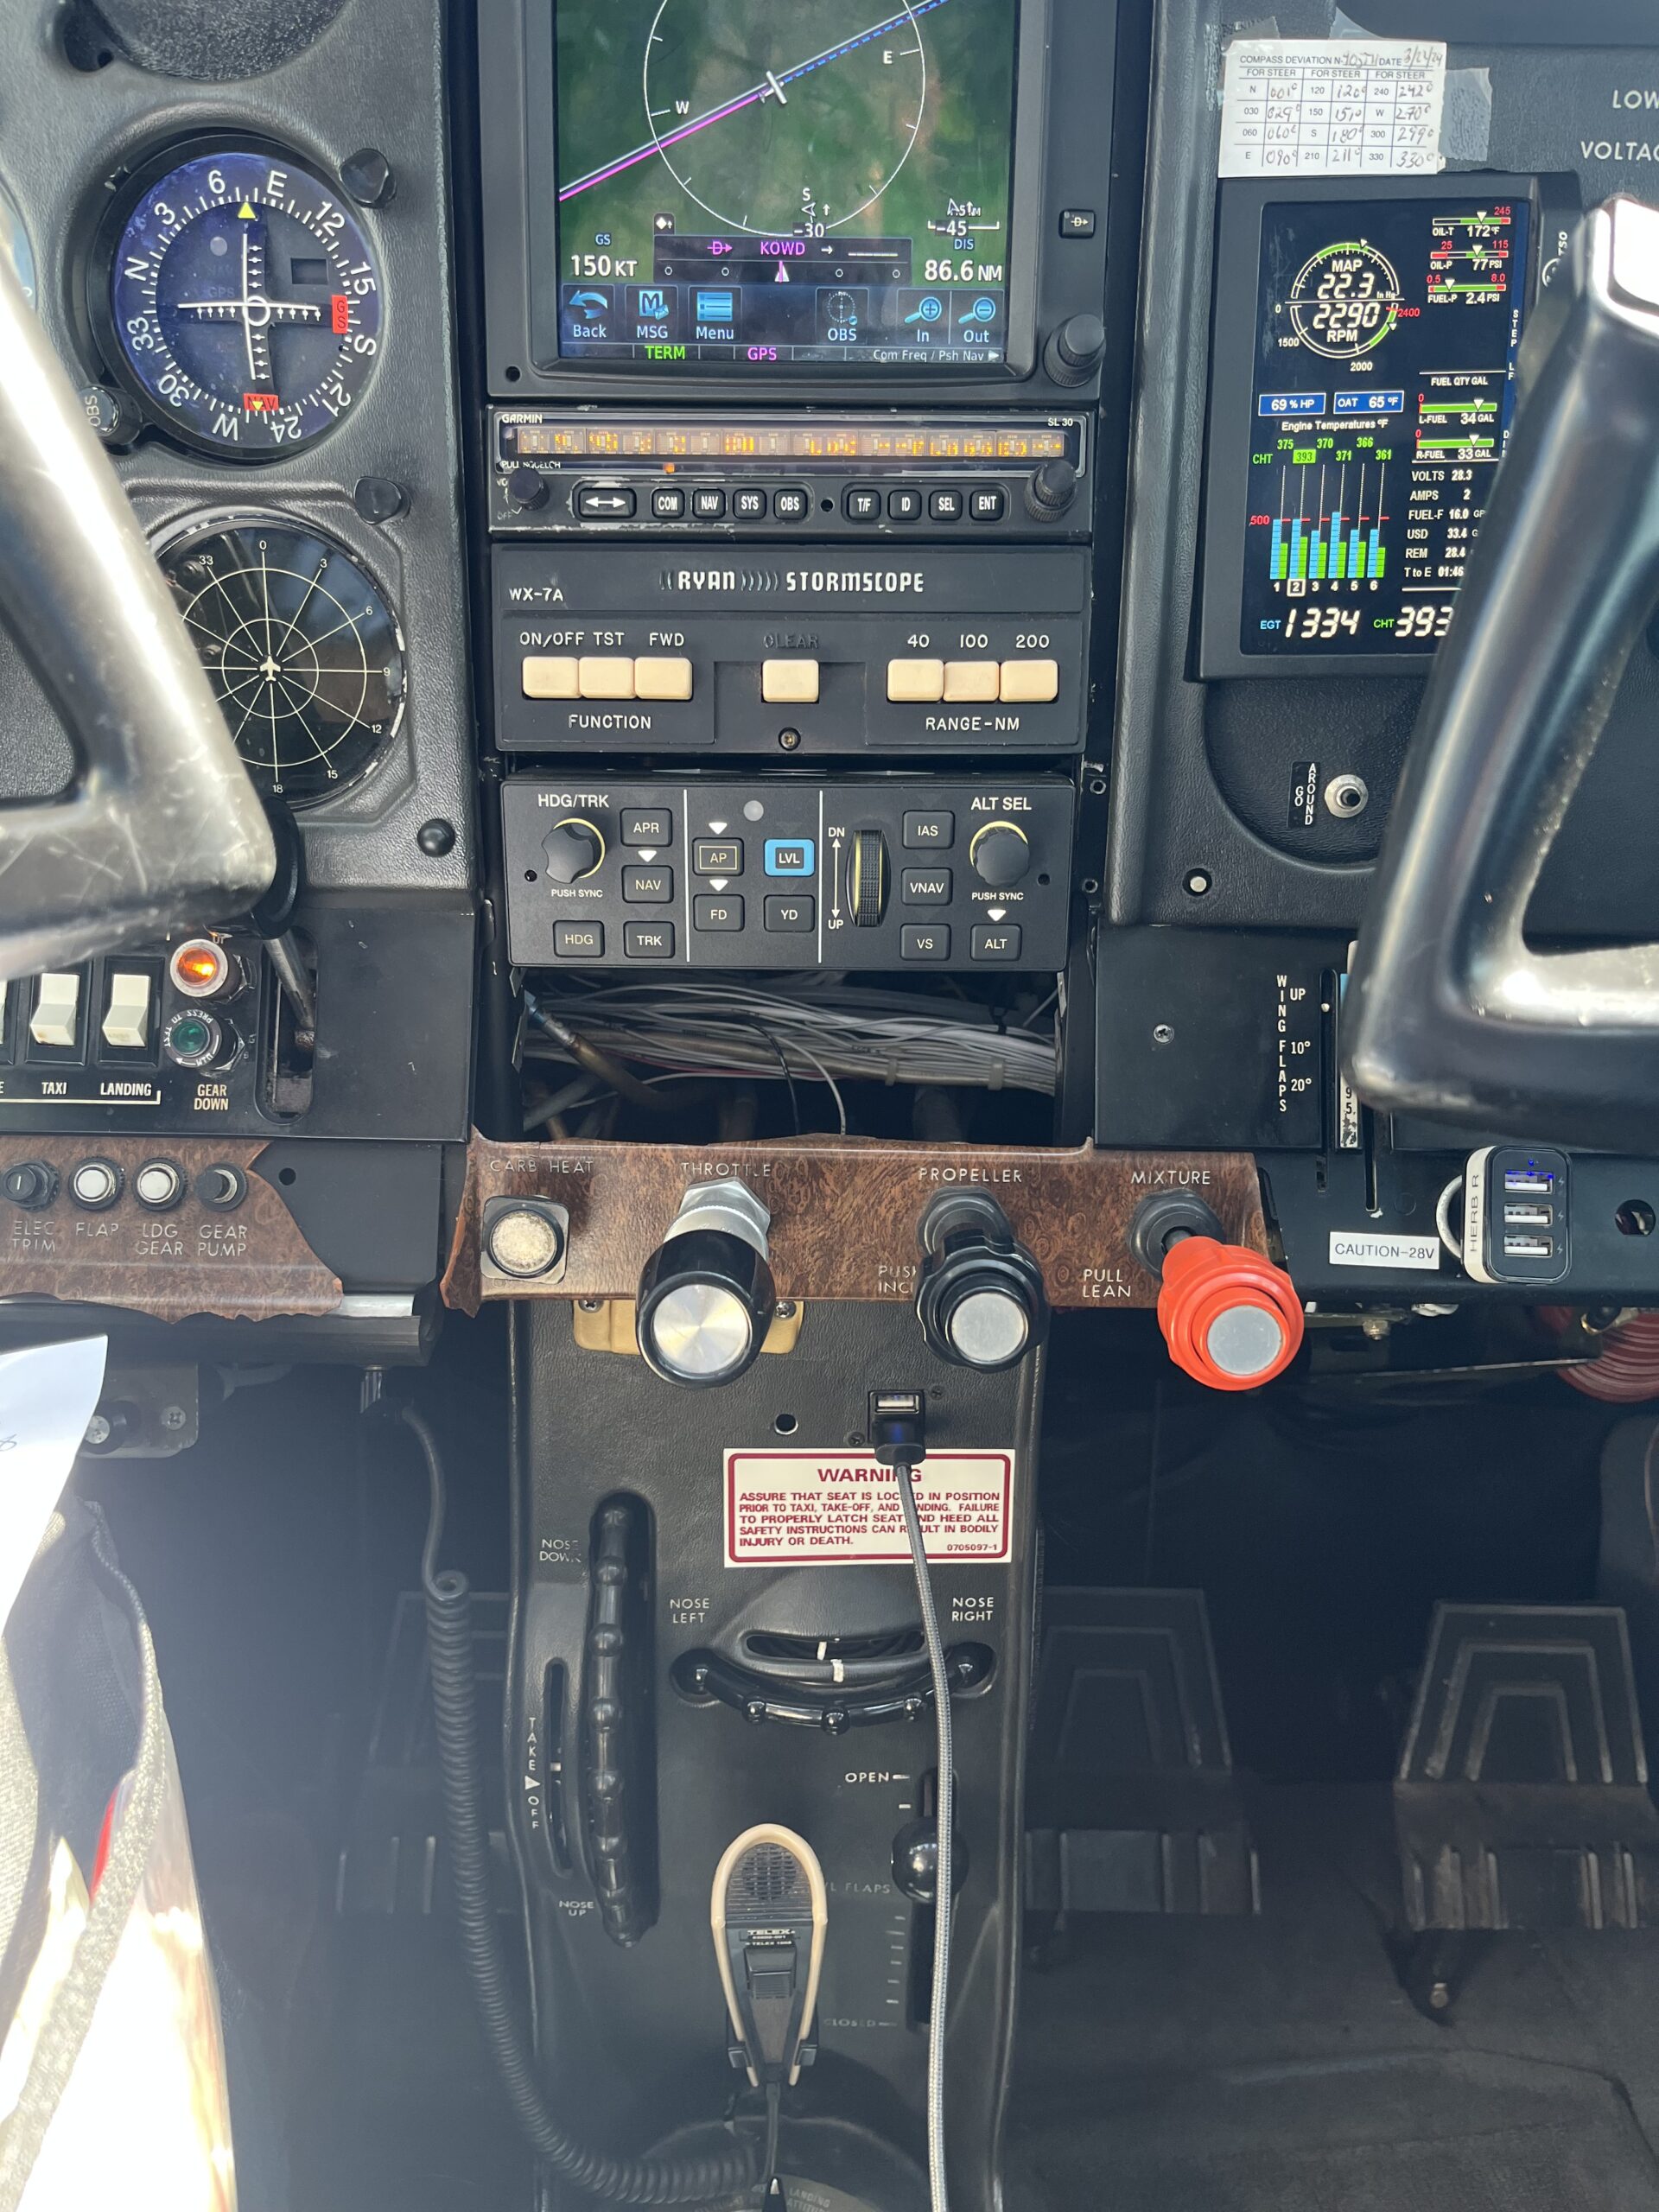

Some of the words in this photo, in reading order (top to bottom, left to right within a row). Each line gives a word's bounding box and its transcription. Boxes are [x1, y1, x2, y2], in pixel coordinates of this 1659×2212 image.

[1240, 55, 1284, 64] COMPASS
[1286, 56, 1332, 65] DEVIATION
[1268, 68, 1296, 77] STEER
[208, 170, 226, 194] 6
[266, 170, 288, 198] E
[154, 201, 176, 226] 3
[315, 201, 346, 238] 12
[1432, 227, 1454, 237] OIL-T
[1466, 225, 1491, 238] 172
[594, 233, 611, 246] GS
[954, 238, 975, 251] DIS
[760, 241, 806, 257] KOWD
[124, 257, 149, 282] N
[571, 255, 612, 277] 150
[614, 260, 639, 277] KT
[924, 261, 975, 281] 86.6
[977, 264, 1003, 282] NM
[1332, 260, 1363, 273] MAP
[349, 261, 377, 296] 15
[1317, 274, 1375, 300] 22.3
[1427, 294, 1458, 304] FUEL-P
[1313, 302, 1381, 329] 2290
[1397, 308, 1421, 317] 2400
[127, 316, 155, 352] 33
[572, 324, 607, 339] Back
[636, 326, 669, 340] MSG
[696, 326, 734, 340] Menu
[827, 327, 857, 342] OBS
[916, 329, 931, 343] In
[963, 329, 990, 343] Out
[1326, 330, 1358, 343] RPM
[353, 334, 378, 357] S
[1278, 337, 1300, 347] 1500
[645, 346, 686, 360] TERM
[747, 346, 778, 361] GPS
[873, 348, 895, 361] Com
[899, 348, 928, 363] Freq
[939, 349, 959, 362] Psh
[963, 351, 985, 363] Nav
[1350, 361, 1373, 372] 2000
[157, 373, 190, 408] 30
[321, 381, 352, 417] 21
[1338, 397, 1358, 408] OAT
[1369, 397, 1384, 409] 65
[85, 395, 101, 427] OBS
[501, 414, 543, 424] GARMIN
[212, 413, 239, 442] W
[270, 416, 302, 443] 24
[1281, 421, 1313, 433] Engine
[1315, 420, 1376, 431] Temperatures
[1411, 470, 1446, 481] VOLTS
[1451, 470, 1472, 481] 28.3
[658, 496, 678, 511] COM
[701, 496, 719, 510] NAV
[741, 495, 759, 510] SYS
[780, 497, 800, 511] OBS
[857, 498, 872, 513] T/F
[901, 497, 911, 512] ID
[938, 497, 955, 512] SEL
[978, 496, 997, 511] ENT
[1408, 509, 1444, 520] FUEL-F
[199, 556, 213, 565] 33
[1405, 548, 1428, 559] REM
[677, 571, 736, 592] RYAN
[785, 571, 925, 594] STORMSCOPE
[508, 587, 564, 602] WX-7A
[1260, 620, 1281, 630] EGT
[1284, 607, 1361, 639] 1334
[519, 632, 585, 647] ON/OFF
[592, 632, 625, 646] TST
[649, 632, 685, 647] FWD
[762, 633, 820, 650] CLEAR
[906, 633, 931, 649] 40
[958, 633, 989, 649] 100
[1014, 633, 1050, 650] 200
[568, 714, 653, 731] FUNCTION
[327, 770, 339, 779] 15
[272, 784, 283, 794] 18
[1294, 785, 1304, 807] GO
[1304, 762, 1317, 826] AROUND
[537, 794, 609, 809] HDG/TRK
[970, 797, 999, 811] ALT
[1002, 797, 1033, 810] SEL
[633, 823, 659, 834] APR
[828, 826, 845, 838] DN
[917, 825, 939, 836] IAS
[709, 852, 728, 863] AP
[778, 852, 801, 864] LVL
[635, 880, 662, 891] NAV
[909, 882, 945, 893] VNAV
[551, 888, 576, 898] PUSH
[578, 888, 604, 899] SYNC
[710, 909, 728, 920] FD
[780, 909, 798, 920] YD
[828, 919, 844, 931] UP
[564, 934, 594, 945] HDG
[637, 935, 662, 946] TRK
[917, 938, 933, 950] VS
[984, 938, 1007, 950] ALT
[1289, 988, 1306, 1001] UP
[1277, 975, 1287, 1033] WING
[1290, 1040, 1311, 1055] 10°
[41, 1082, 67, 1095] TAXI
[100, 1083, 152, 1096] LANDING
[197, 1084, 227, 1097] GEAR
[1290, 1077, 1313, 1092] 20°
[194, 1097, 229, 1110] DOWN
[490, 1160, 537, 1173] CARB
[550, 1160, 594, 1173] HEAT
[918, 1167, 1022, 1184] PROPELLER
[1131, 1170, 1211, 1185] MIXTURE
[14, 1220, 55, 1236] ELEC
[76, 1222, 119, 1237] FLAP
[142, 1224, 178, 1238] LDG
[199, 1224, 248, 1239] GEAR
[12, 1238, 56, 1252] TRIM
[136, 1241, 184, 1255] GEAR
[198, 1243, 246, 1256] PUMP
[1335, 1243, 1435, 1260] CAUTION-28V
[1084, 1268, 1124, 1282] PULL
[1082, 1284, 1131, 1298] LEAN
[740, 1492, 786, 1502] ASSURE
[791, 1492, 823, 1502] THAT
[827, 1492, 856, 1502] SEAT
[945, 1492, 1001, 1502] POSITION
[739, 1503, 769, 1513] PRIOR
[959, 1503, 1000, 1512] FAILURE
[760, 1515, 823, 1524] PROPERLY
[827, 1515, 868, 1523] LATCH
[740, 1526, 781, 1535] SAFETY
[786, 1525, 868, 1535] INSTRUCTIONS
[960, 1525, 998, 1534] BODILY
[739, 1537, 784, 1547] INJURY
[810, 1536, 854, 1546] DEATH.
[947, 1543, 998, 1552] 0705097-1
[670, 1599, 710, 1610] NOSE
[952, 1597, 995, 1609] NOSE
[672, 1612, 706, 1624] LEFT
[951, 1610, 994, 1623] RIGHT
[845, 1772, 889, 1783] OPEN
